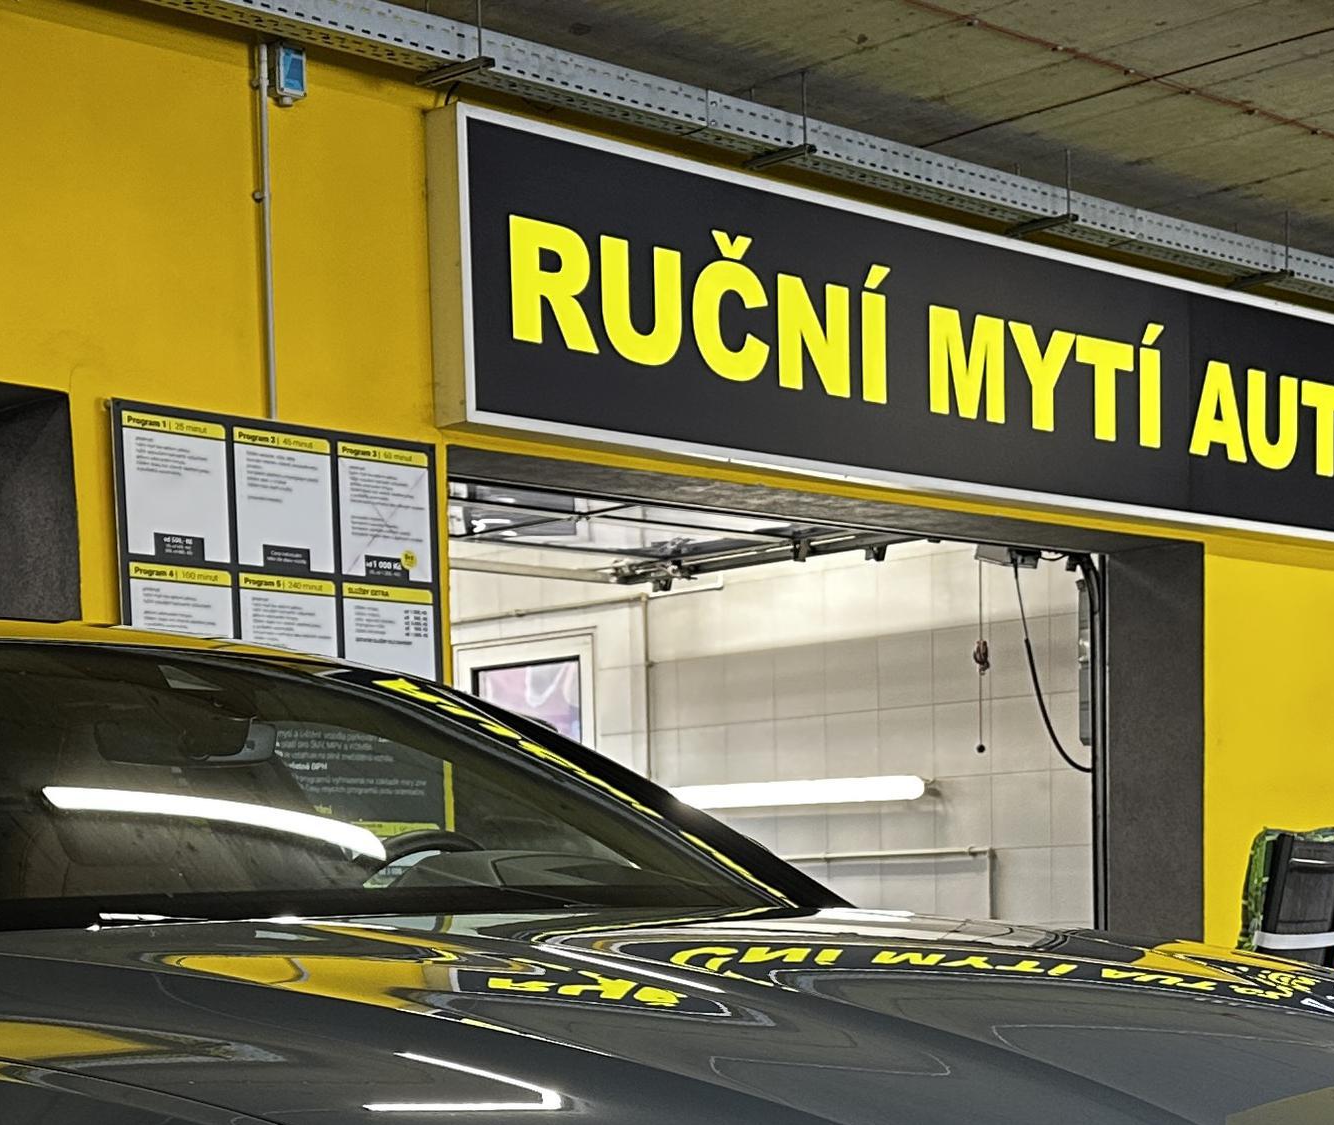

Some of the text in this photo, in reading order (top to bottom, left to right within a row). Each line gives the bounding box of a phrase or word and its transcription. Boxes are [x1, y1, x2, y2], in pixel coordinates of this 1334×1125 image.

[508, 214, 891, 405] RUČNÍ
[928, 305, 1164, 449] MYTÍ
[127, 415, 161, 428] Program
[238, 431, 270, 443] Program
[342, 445, 371, 457] Program
[134, 566, 167, 578] Program
[244, 576, 275, 588] Program
